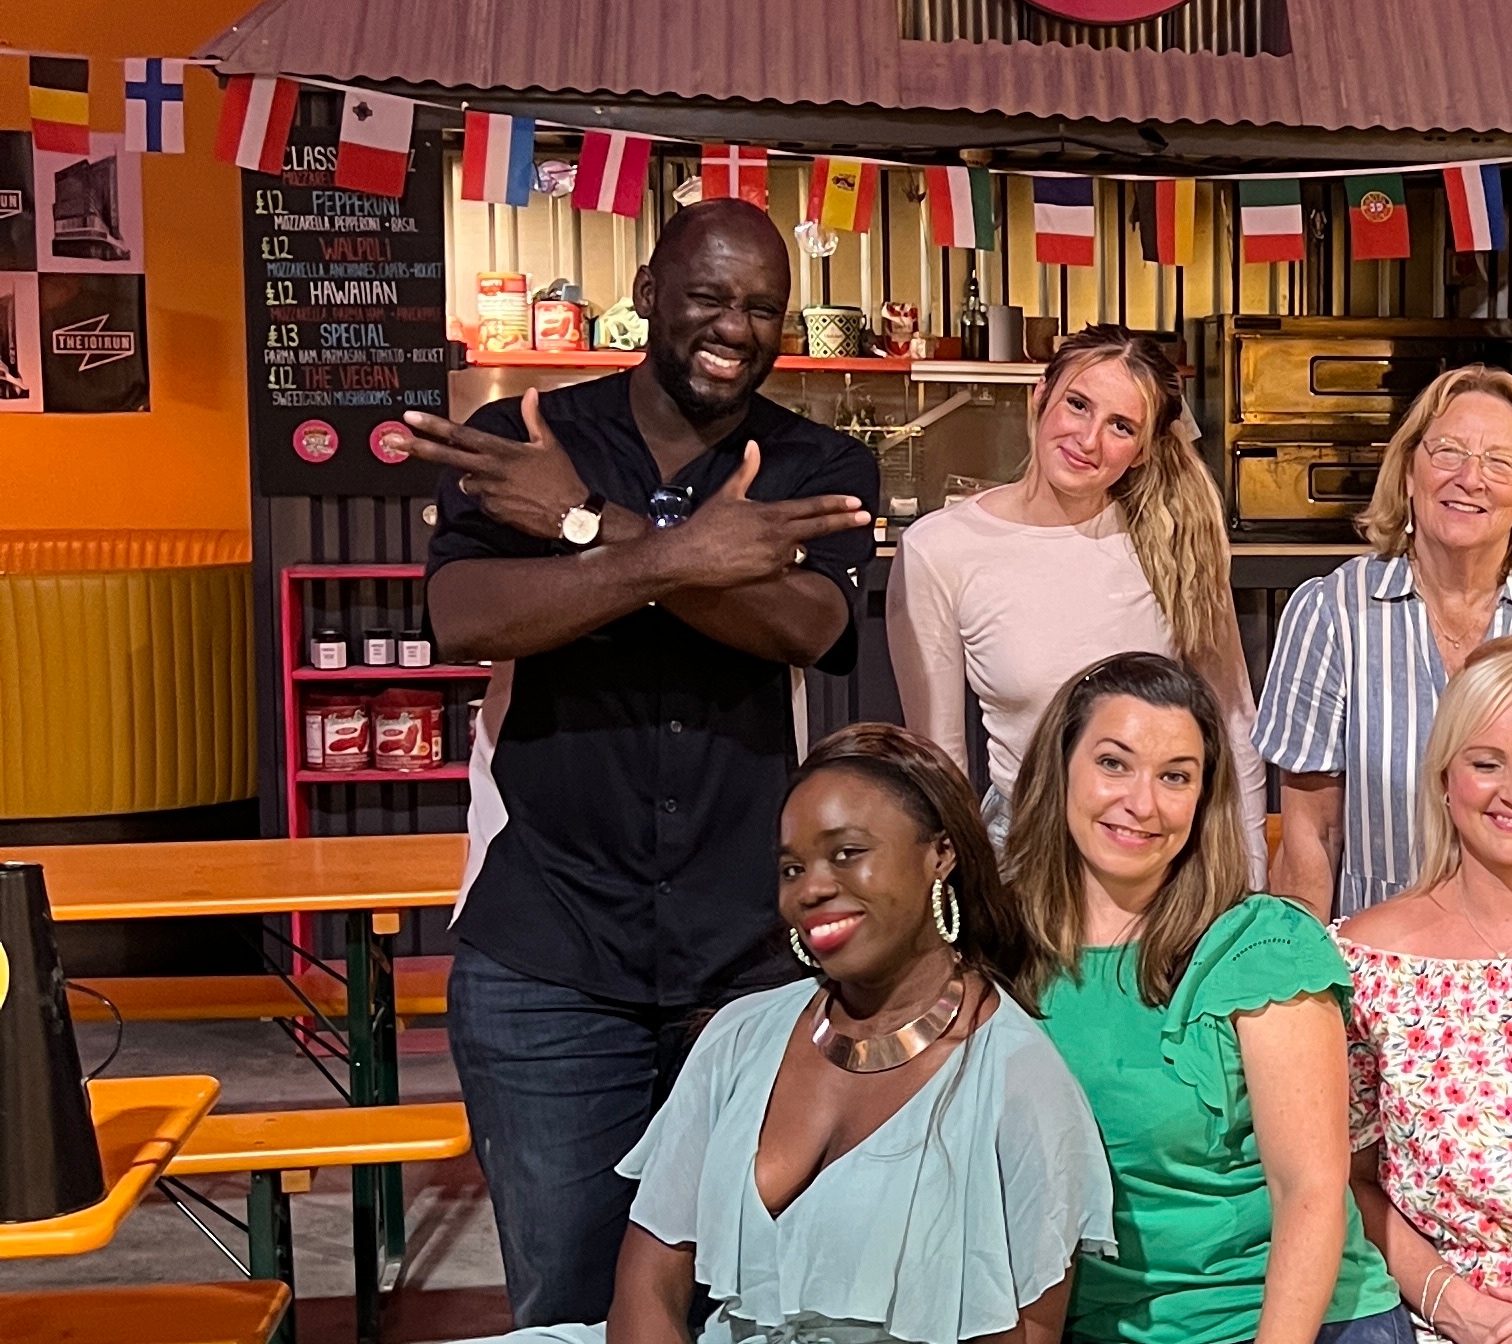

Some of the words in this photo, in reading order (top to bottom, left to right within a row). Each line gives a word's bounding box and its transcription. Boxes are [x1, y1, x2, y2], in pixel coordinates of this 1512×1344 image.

[255, 189, 290, 215] £12
[261, 235, 294, 260] £12
[265, 280, 298, 306] £12
[309, 280, 398, 306] HAWAIIAN
[266, 323, 299, 348] £13
[319, 323, 390, 348] SPECIAL
[267, 366, 298, 390] £12
[301, 365, 332, 389] THE
[339, 365, 400, 390] VEGAN
[404, 389, 442, 406] OLIVES
